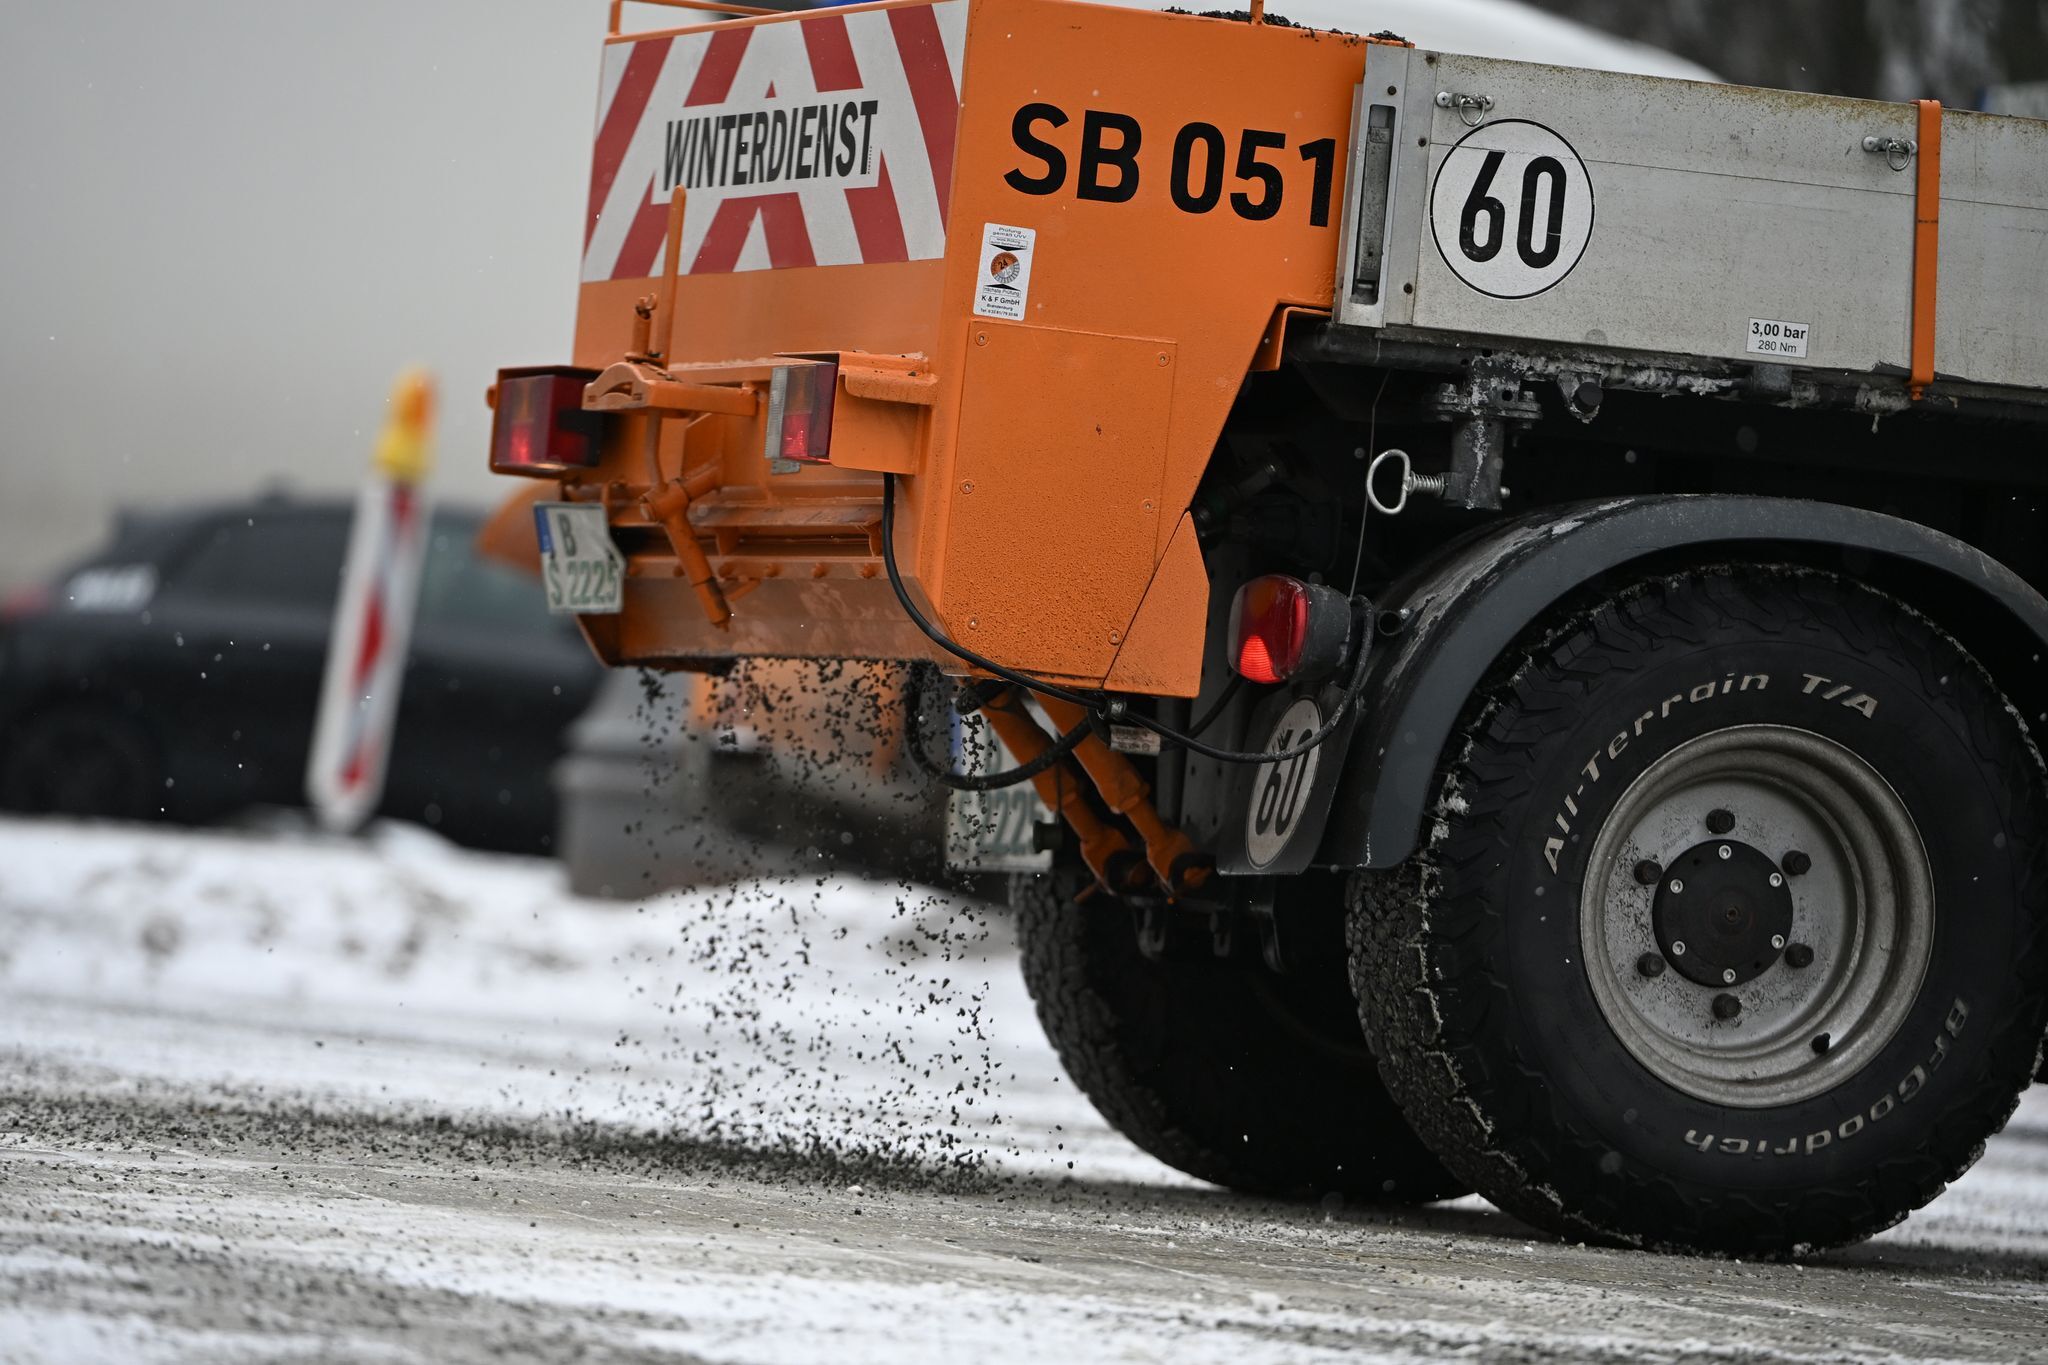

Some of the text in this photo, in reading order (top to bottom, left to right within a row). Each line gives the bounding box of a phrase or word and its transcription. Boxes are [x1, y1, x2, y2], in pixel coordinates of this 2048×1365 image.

[663, 100, 878, 191] WINTERDIENST
[1003, 102, 1336, 227] SB 051
[1459, 150, 1567, 269] 60
[1000, 297, 1020, 306] GmbH
[1752, 322, 1807, 340] 3,00 bar
[1758, 339, 1798, 353] 280 Nm
[557, 513, 577, 557] B
[1255, 728, 1314, 837] 60
[1543, 671, 1879, 875] All-Terrain T/A
[1684, 998, 1969, 1161] BFGoodrich
